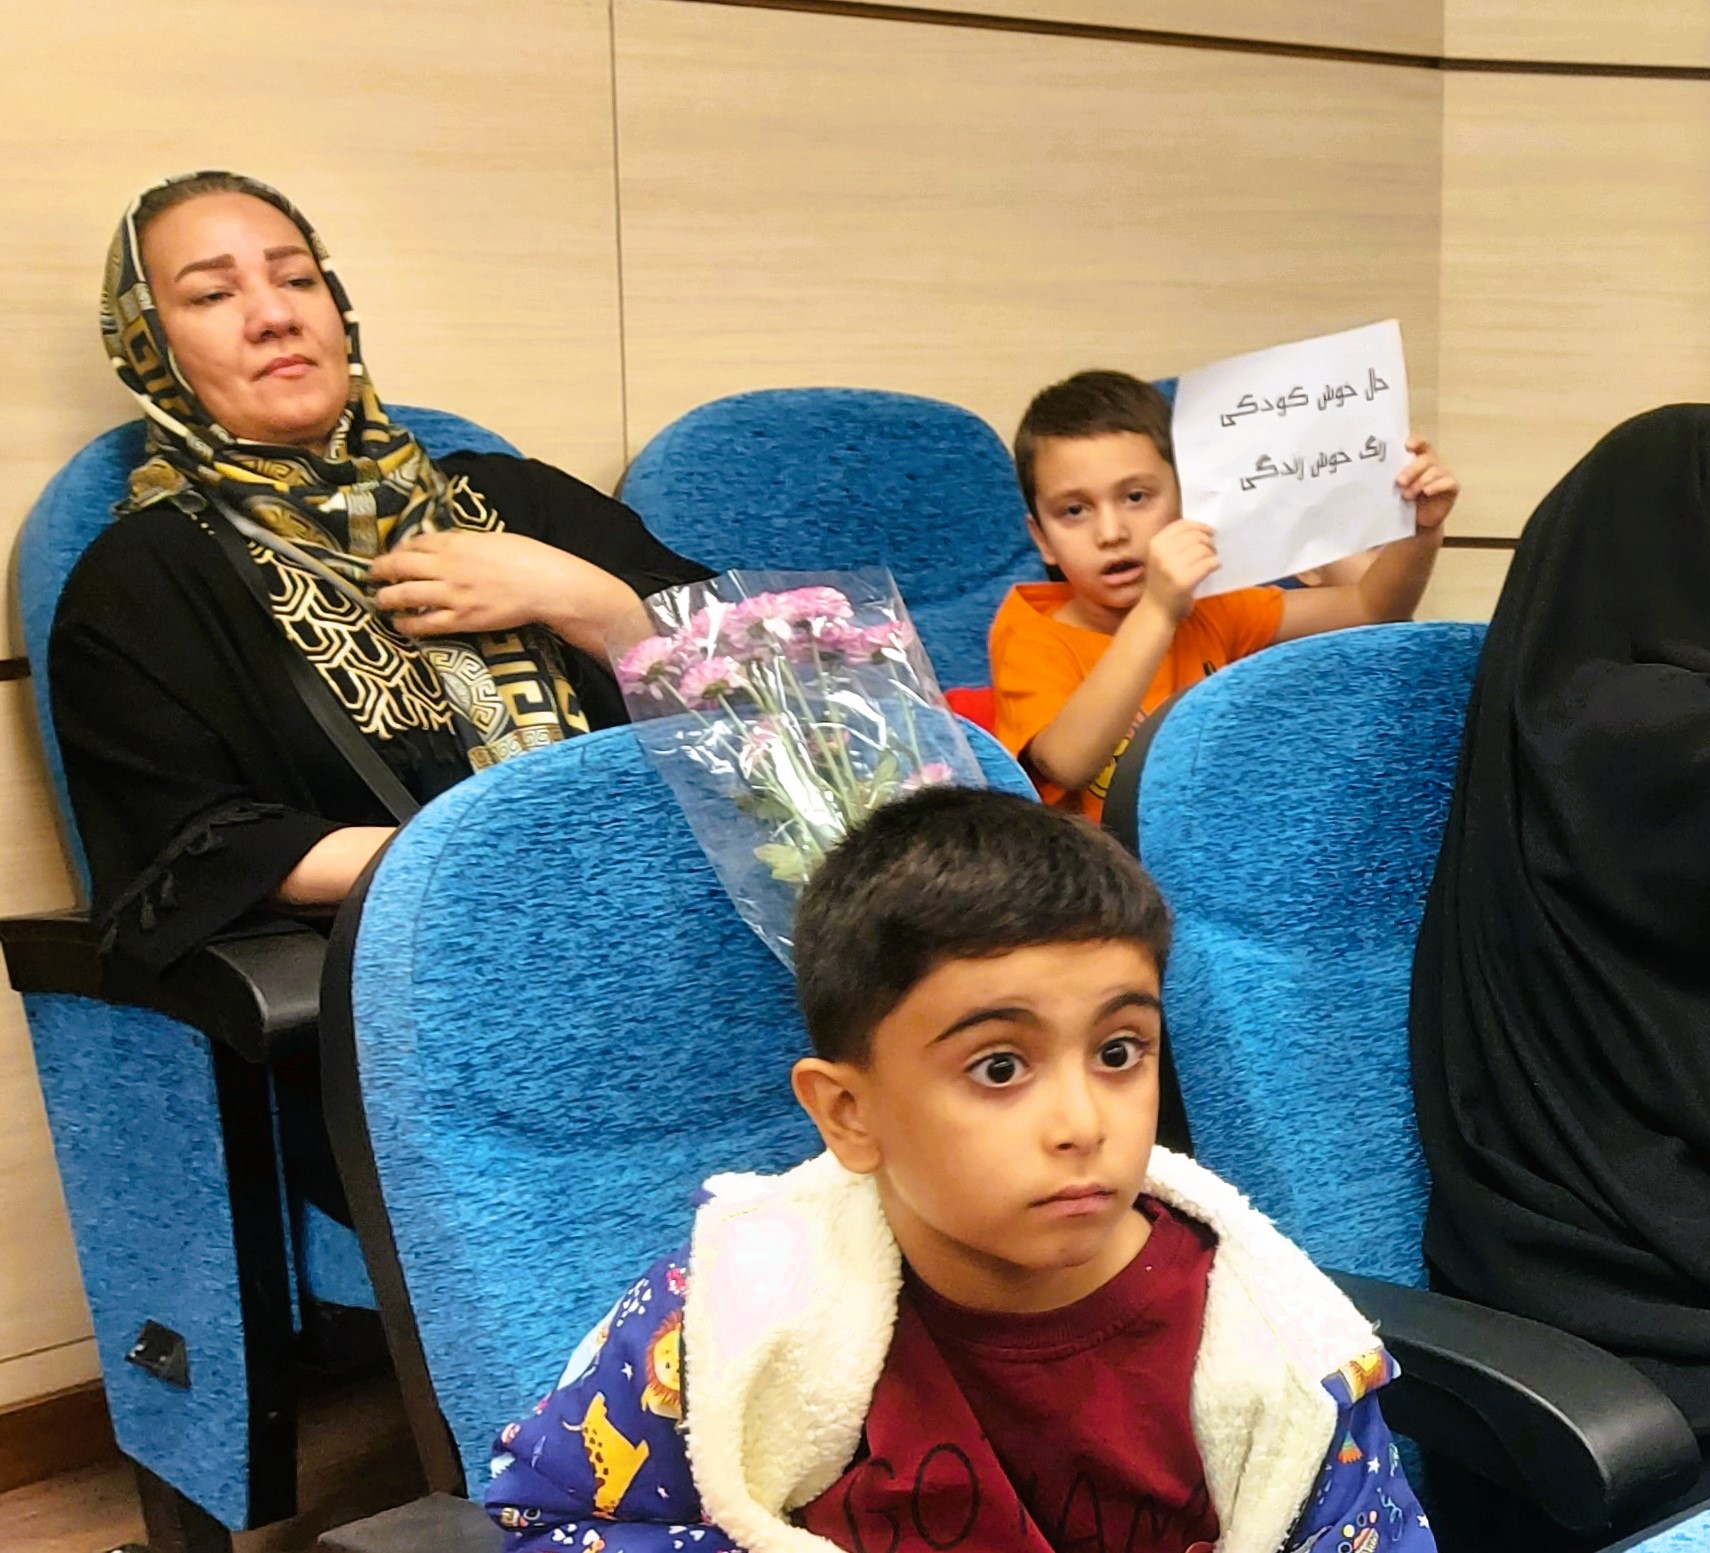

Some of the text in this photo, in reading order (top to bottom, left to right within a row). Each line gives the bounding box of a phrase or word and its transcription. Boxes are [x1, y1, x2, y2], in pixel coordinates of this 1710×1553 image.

[1220, 367, 1390, 427] حال خوش کودکی
[1310, 449, 1352, 479] خوش
